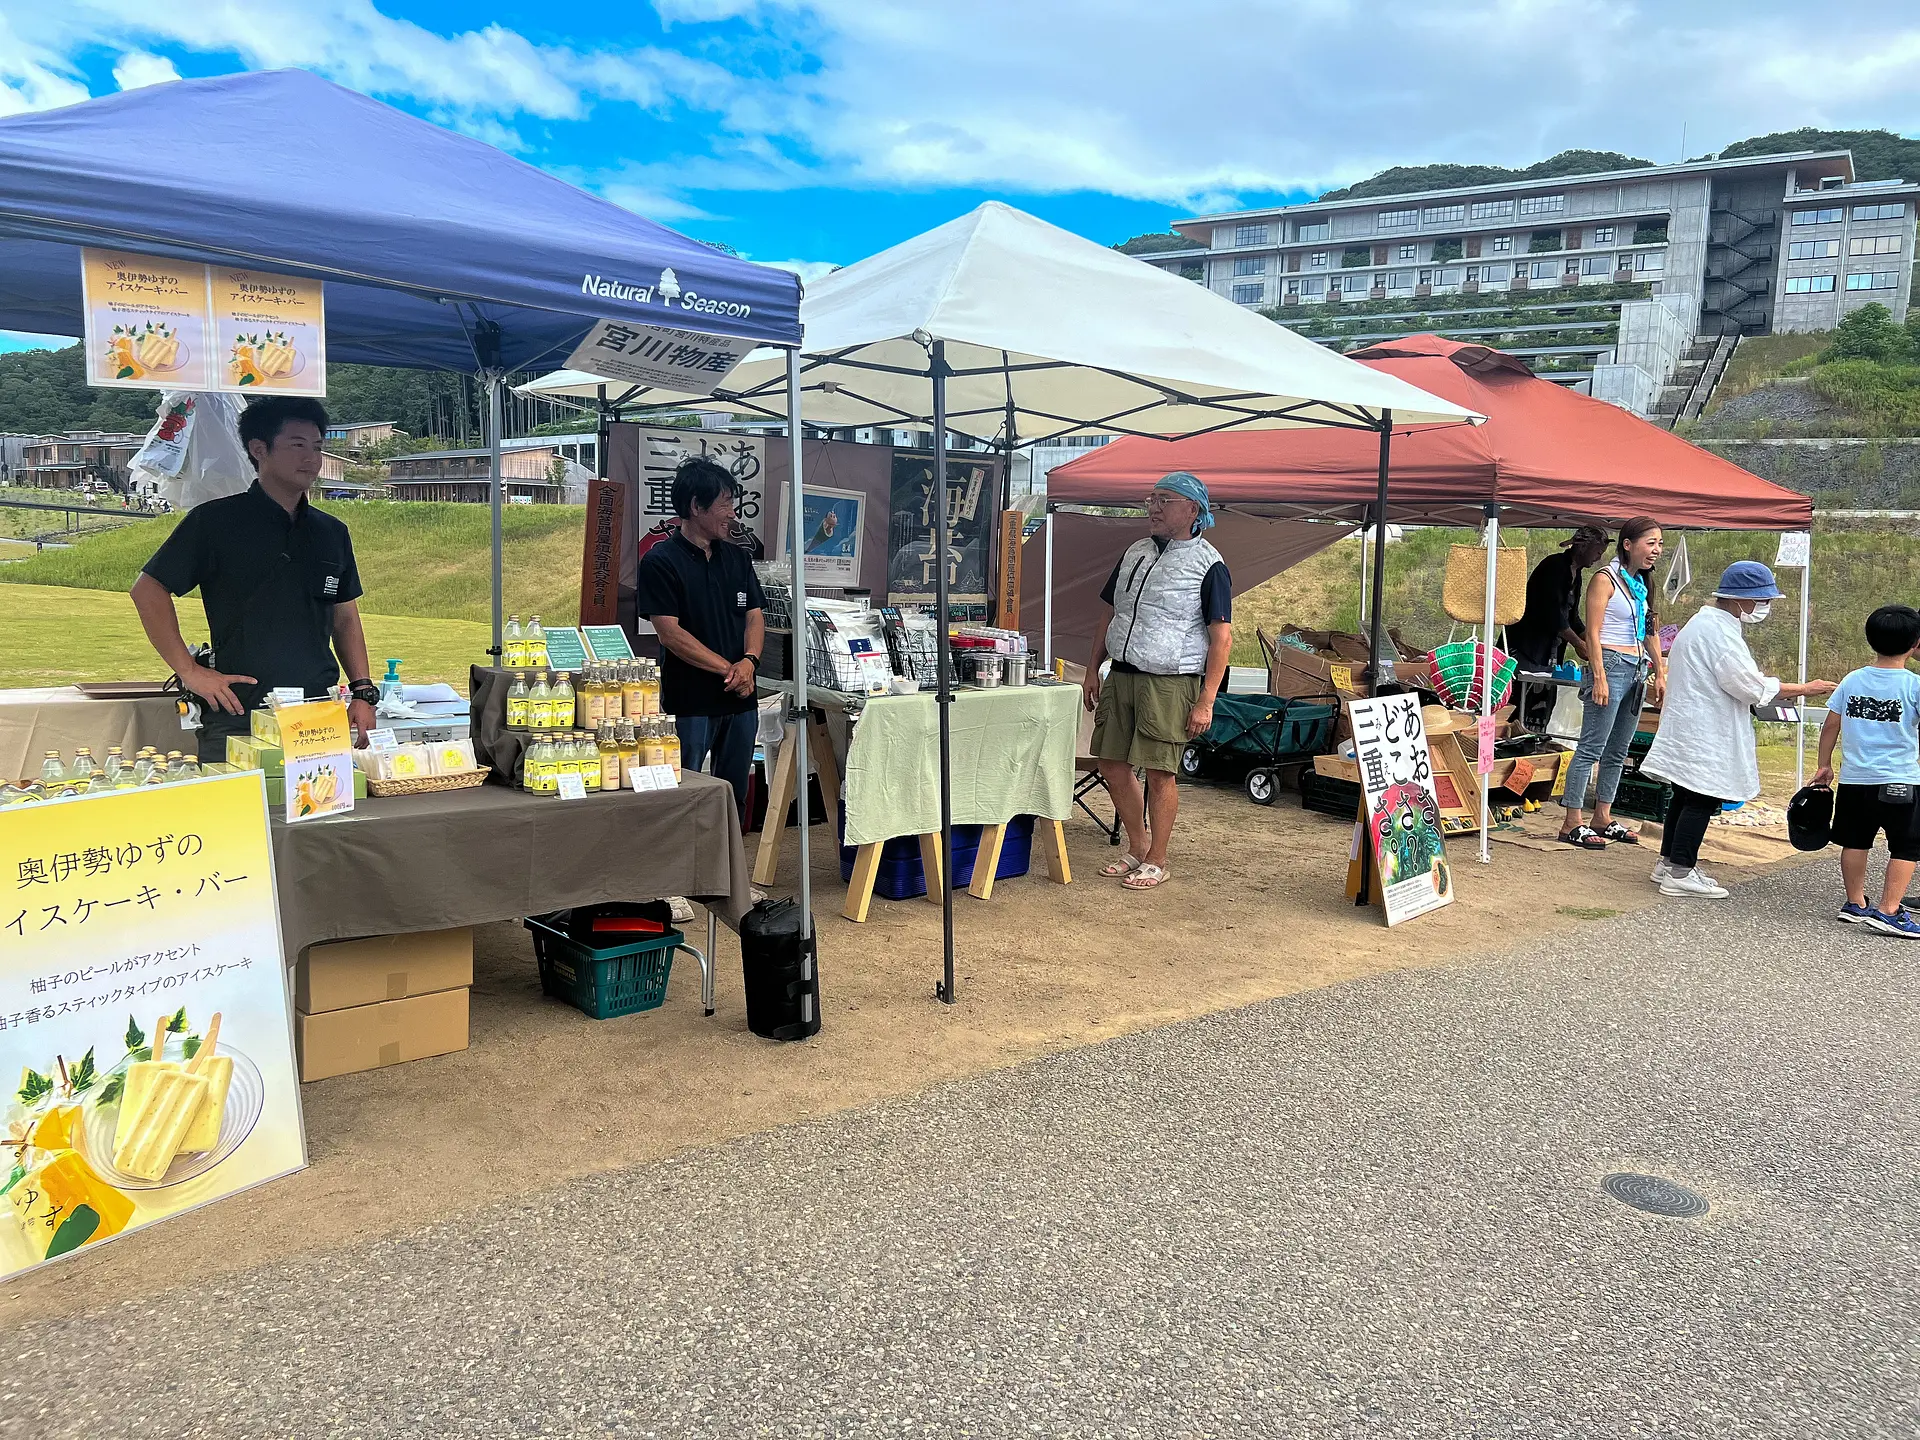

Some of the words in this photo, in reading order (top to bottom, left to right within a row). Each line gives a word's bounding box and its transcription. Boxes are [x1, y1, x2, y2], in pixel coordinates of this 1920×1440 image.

[104, 260, 127, 271] NEW
[117, 271, 178, 285] 奥伊勢ゆずの
[229, 271, 250, 283] NEW
[106, 281, 188, 295] アイスケーキ・バー
[239, 283, 296, 296] 奥伊勢ゆずの
[582, 274, 655, 304] Natural
[680, 291, 751, 319] Season
[596, 323, 739, 373] 宮川物産
[919, 468, 967, 585] 海苔
[17, 833, 203, 890] 奥伊勢ゆずの
[29, 943, 201, 994] 柚子のピールがアクセント
